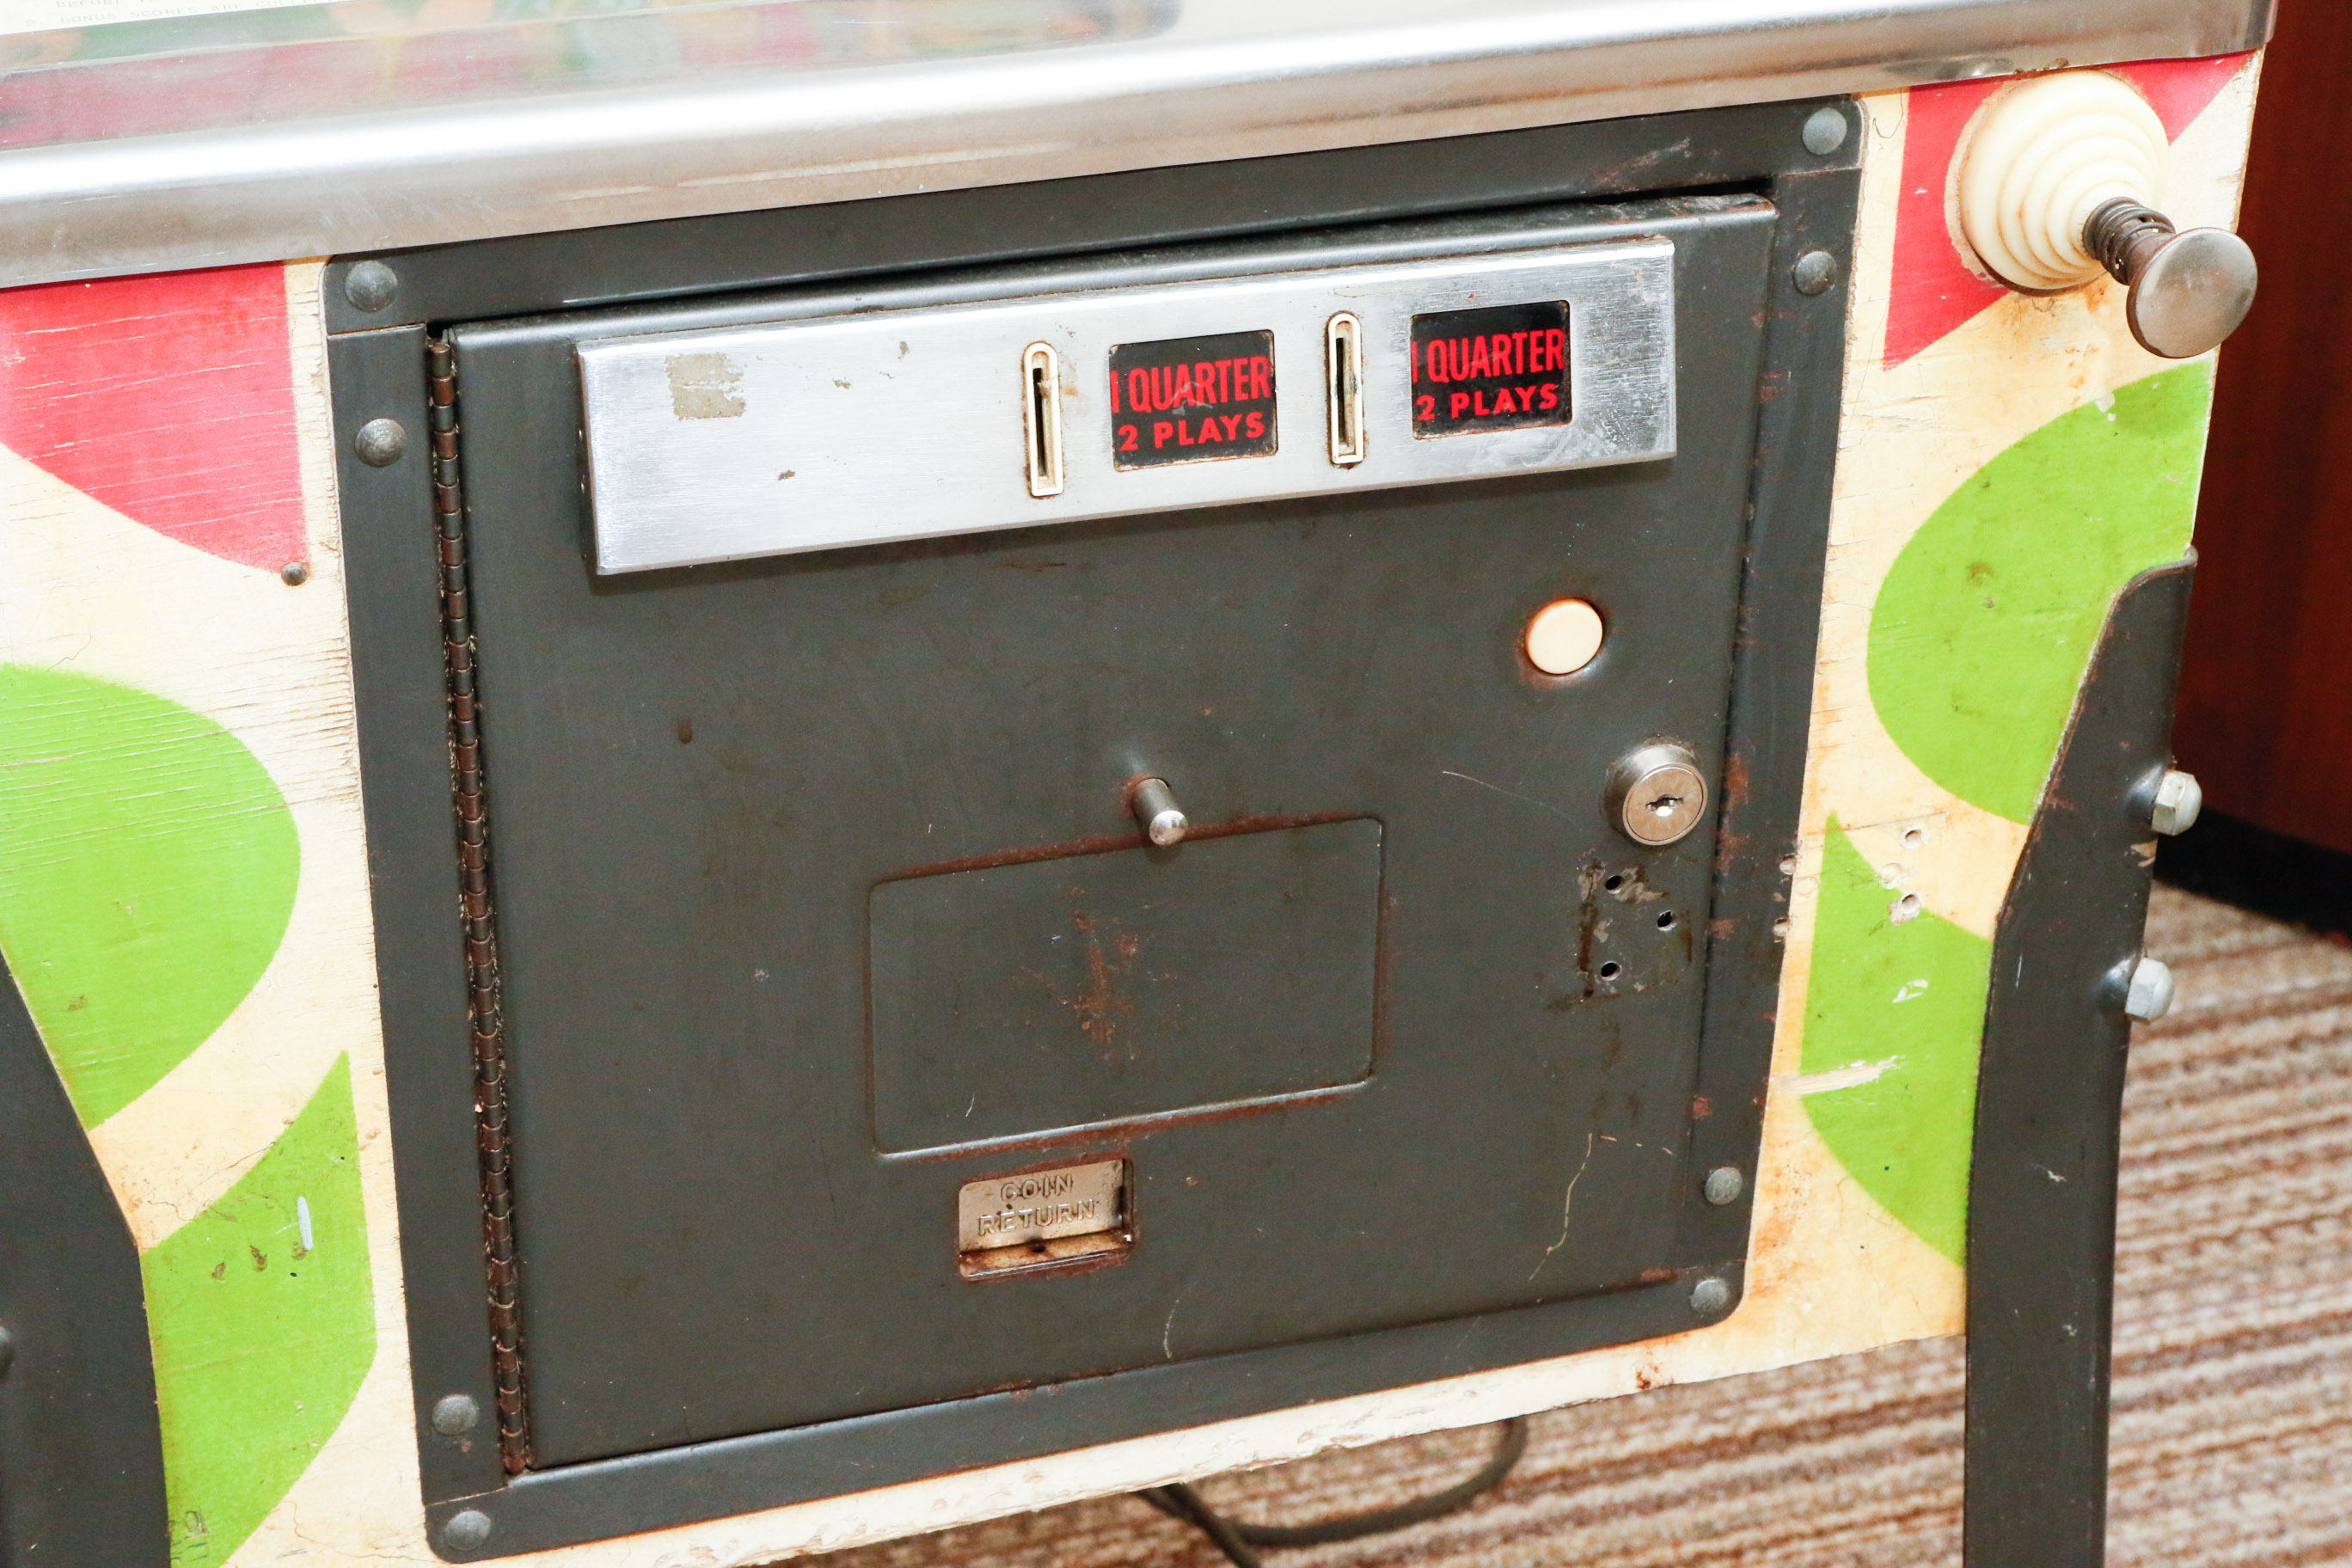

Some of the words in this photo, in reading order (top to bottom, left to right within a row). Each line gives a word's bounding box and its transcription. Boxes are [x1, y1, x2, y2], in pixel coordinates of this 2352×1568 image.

[59, 14, 118, 24] BONUS
[130, 7, 199, 18] SCORES
[211, 3, 242, 11] ARE
[1427, 328, 1565, 383] QUARTER
[1129, 355, 1271, 413] QUARTER
[1416, 395, 1436, 420] 2
[1450, 383, 1559, 419] PLAYS
[1118, 424, 1139, 451] 2
[1153, 411, 1265, 449] PLAYS
[1001, 1173, 1074, 1202] COIN
[977, 1198, 1096, 1237] RETURN
